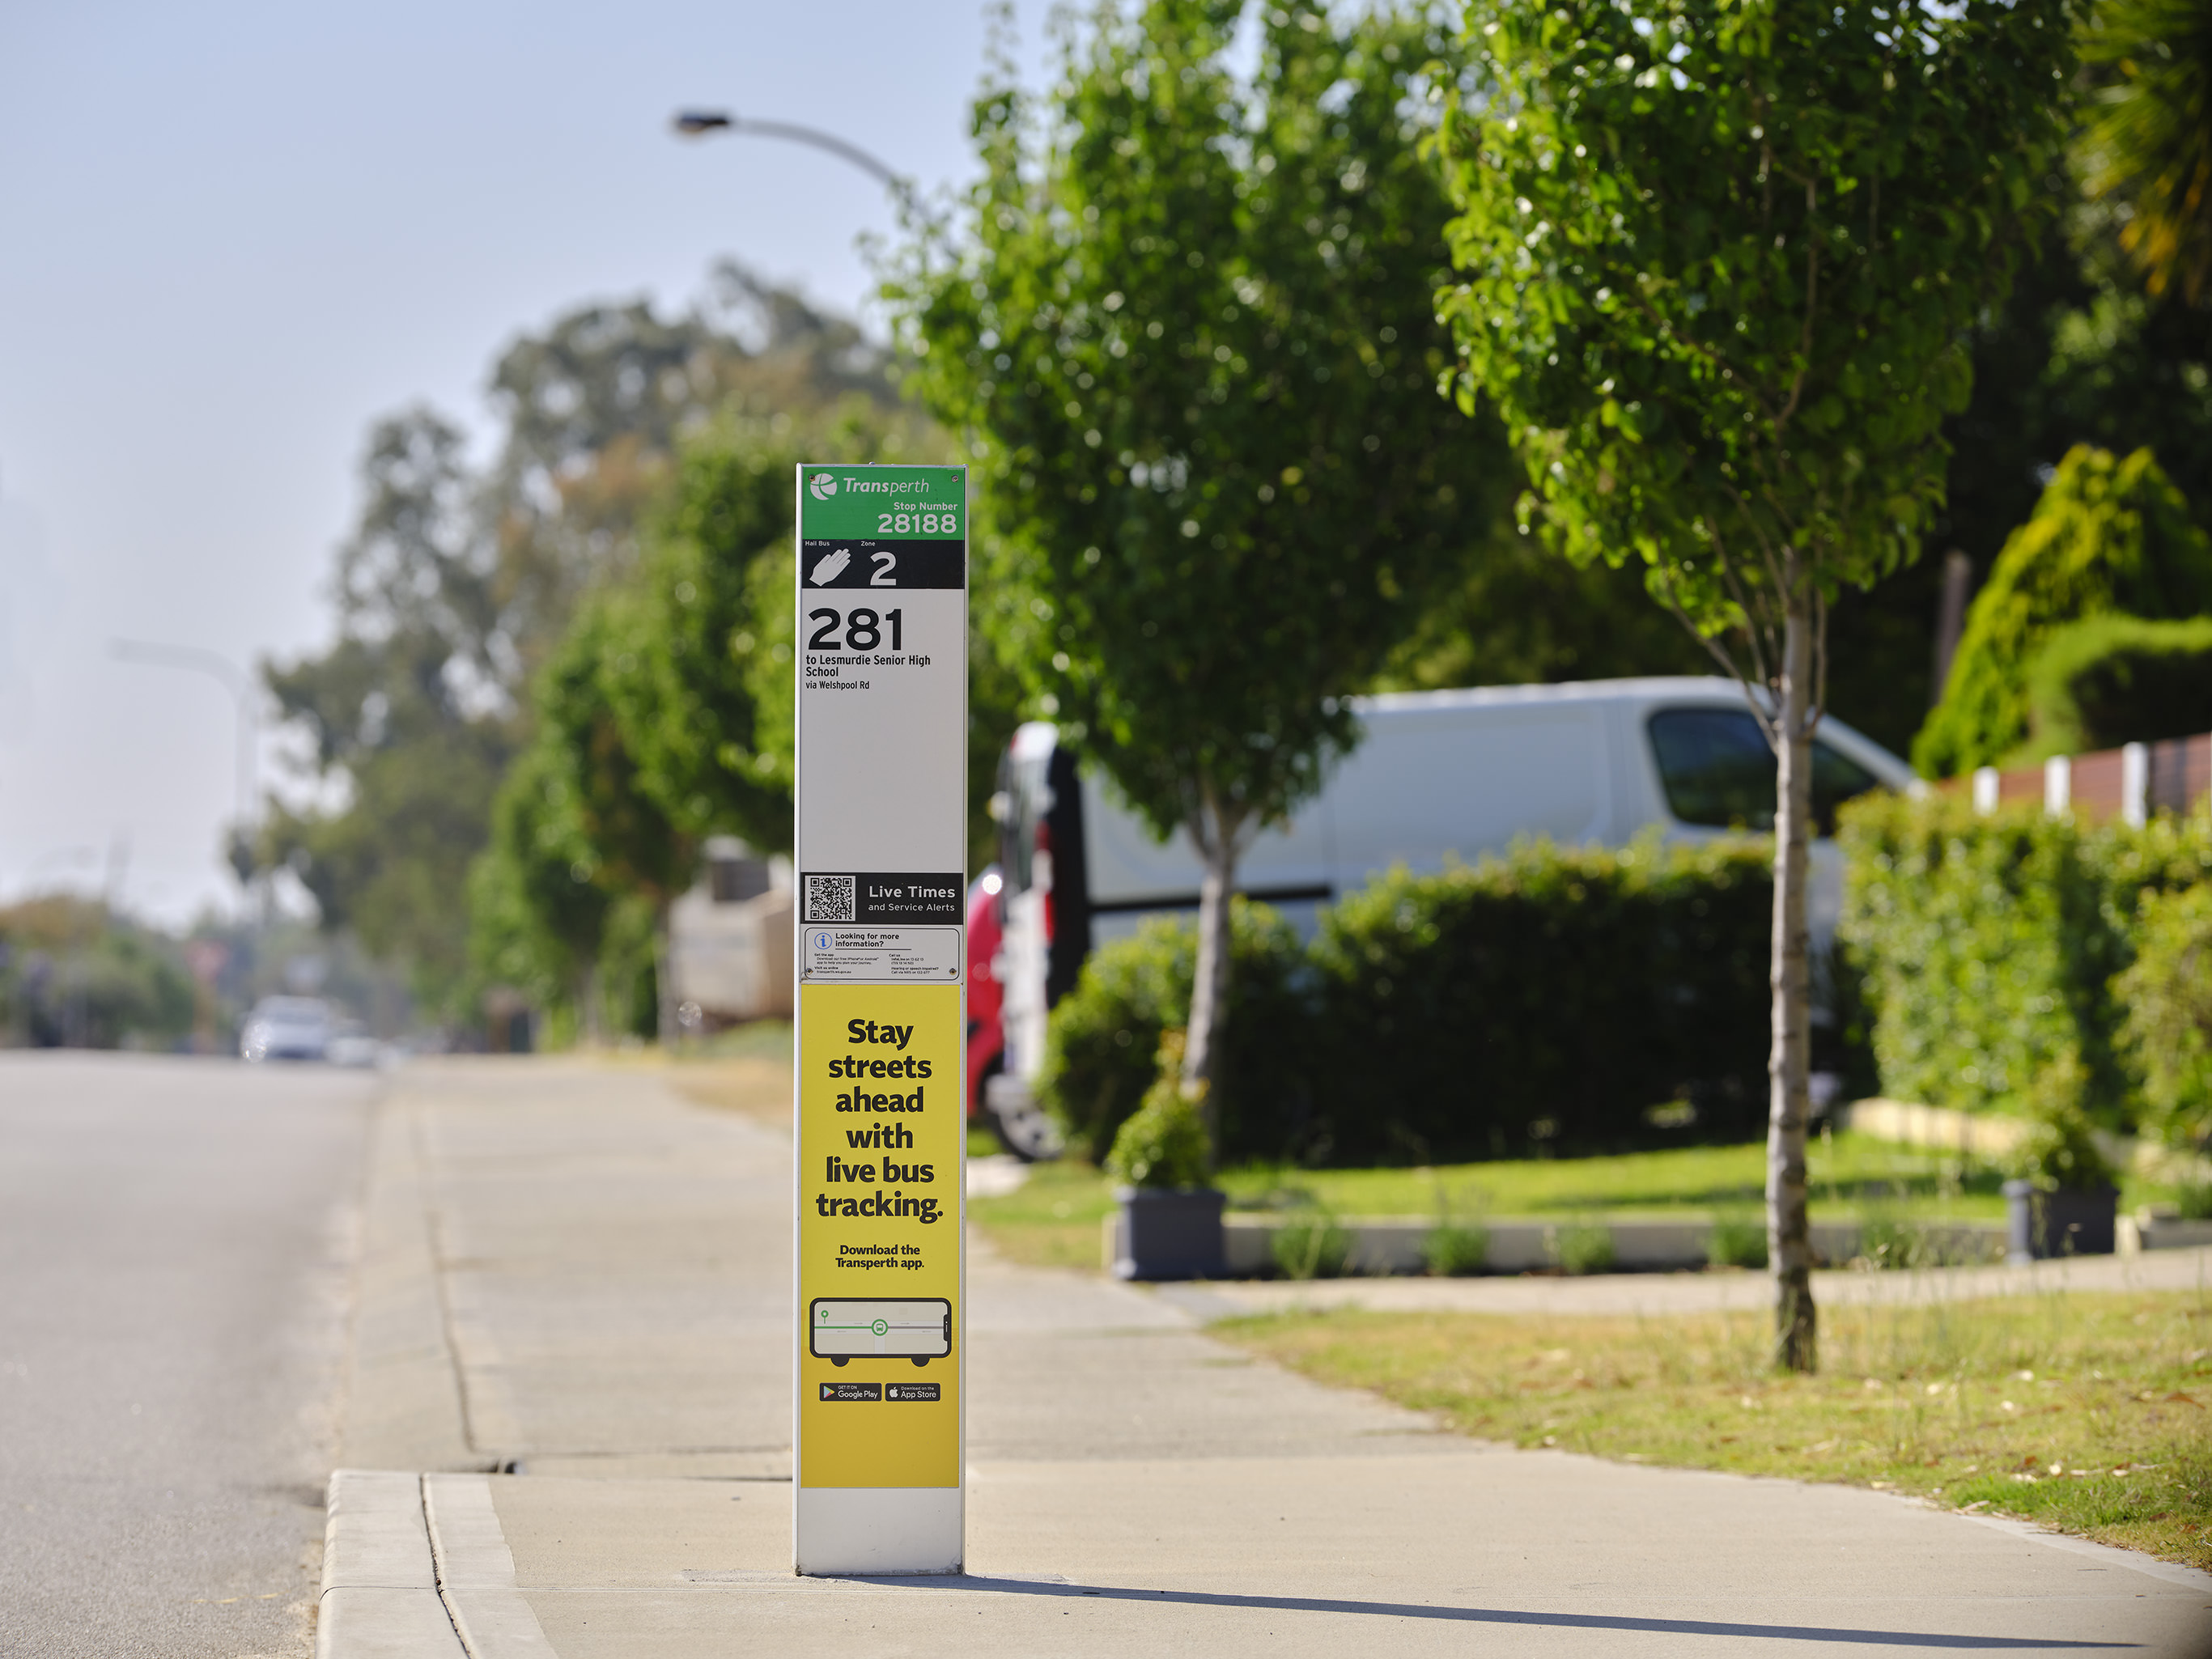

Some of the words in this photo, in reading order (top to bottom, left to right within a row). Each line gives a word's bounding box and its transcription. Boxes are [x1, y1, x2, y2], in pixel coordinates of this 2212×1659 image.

[844, 478, 929, 497] Transperth
[894, 502, 916, 511] Stop
[920, 502, 958, 510] Number
[878, 514, 957, 534] 28188
[870, 551, 897, 586] 2
[808, 608, 902, 651] 281
[806, 656, 816, 665] to
[820, 655, 871, 665] Lesmurdie
[874, 655, 905, 665] Senior
[909, 655, 930, 667] High
[806, 667, 839, 677] School
[819, 681, 857, 691] Welshpool
[860, 681, 869, 689] Rd
[869, 886, 902, 898] Live
[908, 886, 955, 898] Times
[836, 933, 865, 941] Looking
[848, 1019, 914, 1051] Stay
[829, 1055, 932, 1078] streets
[836, 1086, 924, 1112] ahead
[846, 1122, 913, 1149] with
[826, 1156, 875, 1182] live
[883, 1156, 934, 1183] bus
[816, 1190, 943, 1224] tracking.
[840, 1244, 898, 1255] Download
[901, 1245, 920, 1255] the
[836, 1258, 898, 1270] Transperth
[901, 1259, 924, 1270] app.
[838, 1390, 863, 1399] Google
[864, 1390, 878, 1399] Play
